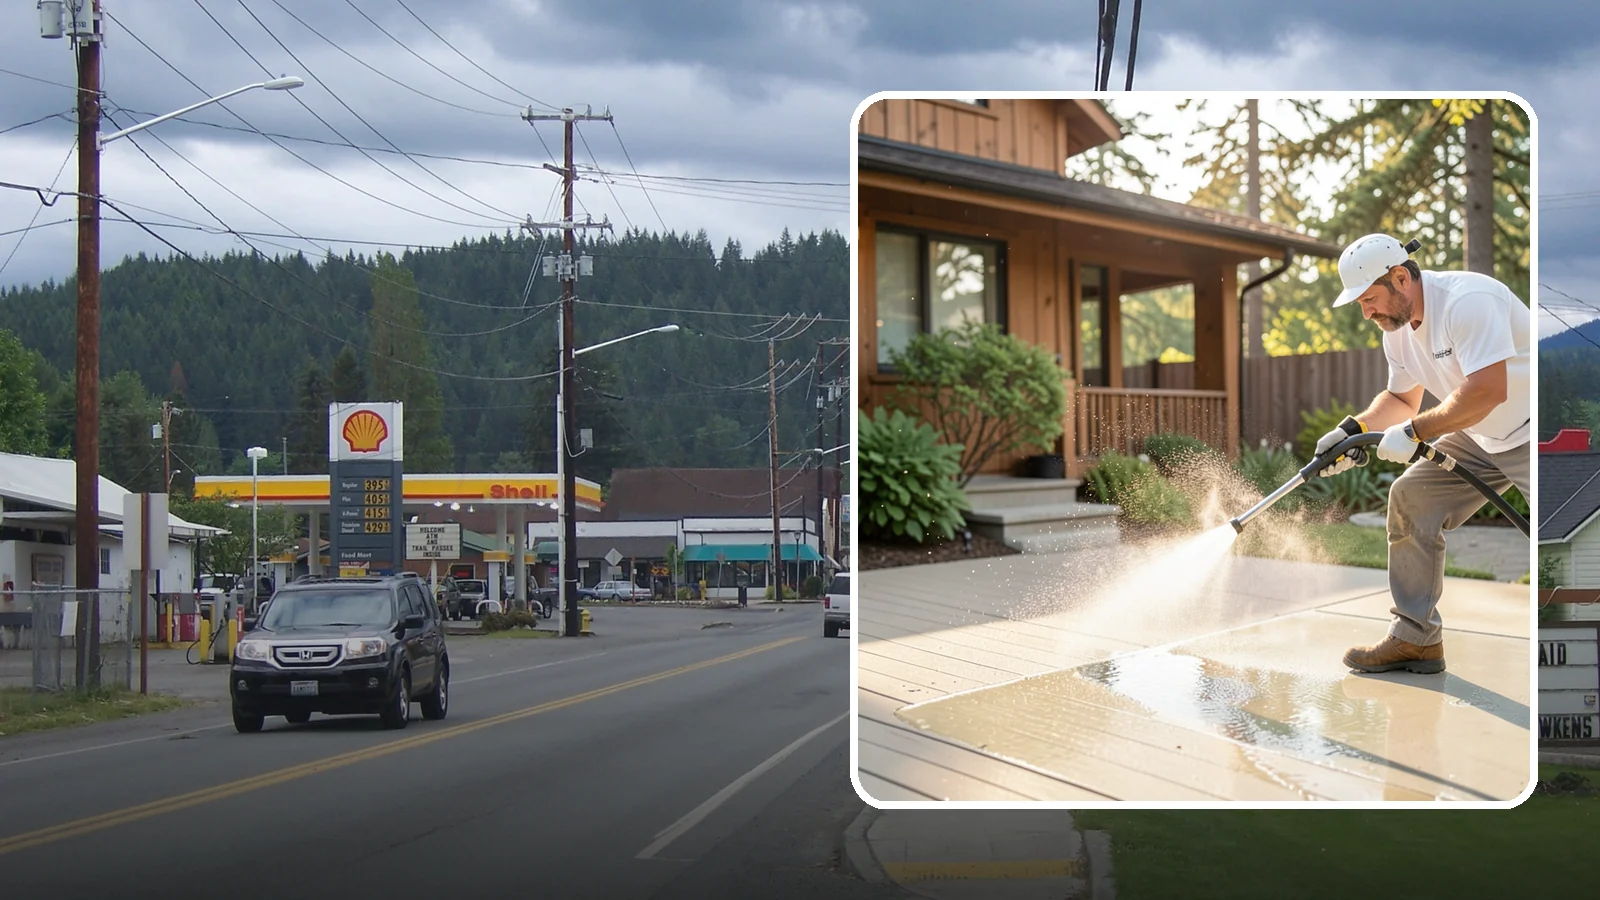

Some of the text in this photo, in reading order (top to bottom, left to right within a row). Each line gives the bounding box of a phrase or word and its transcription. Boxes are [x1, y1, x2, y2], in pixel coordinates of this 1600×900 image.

[365, 480, 383, 490] 395
[490, 484, 547, 498] Shell
[365, 494, 383, 504] 405
[365, 508, 383, 518] 415
[365, 522, 383, 532] 429
